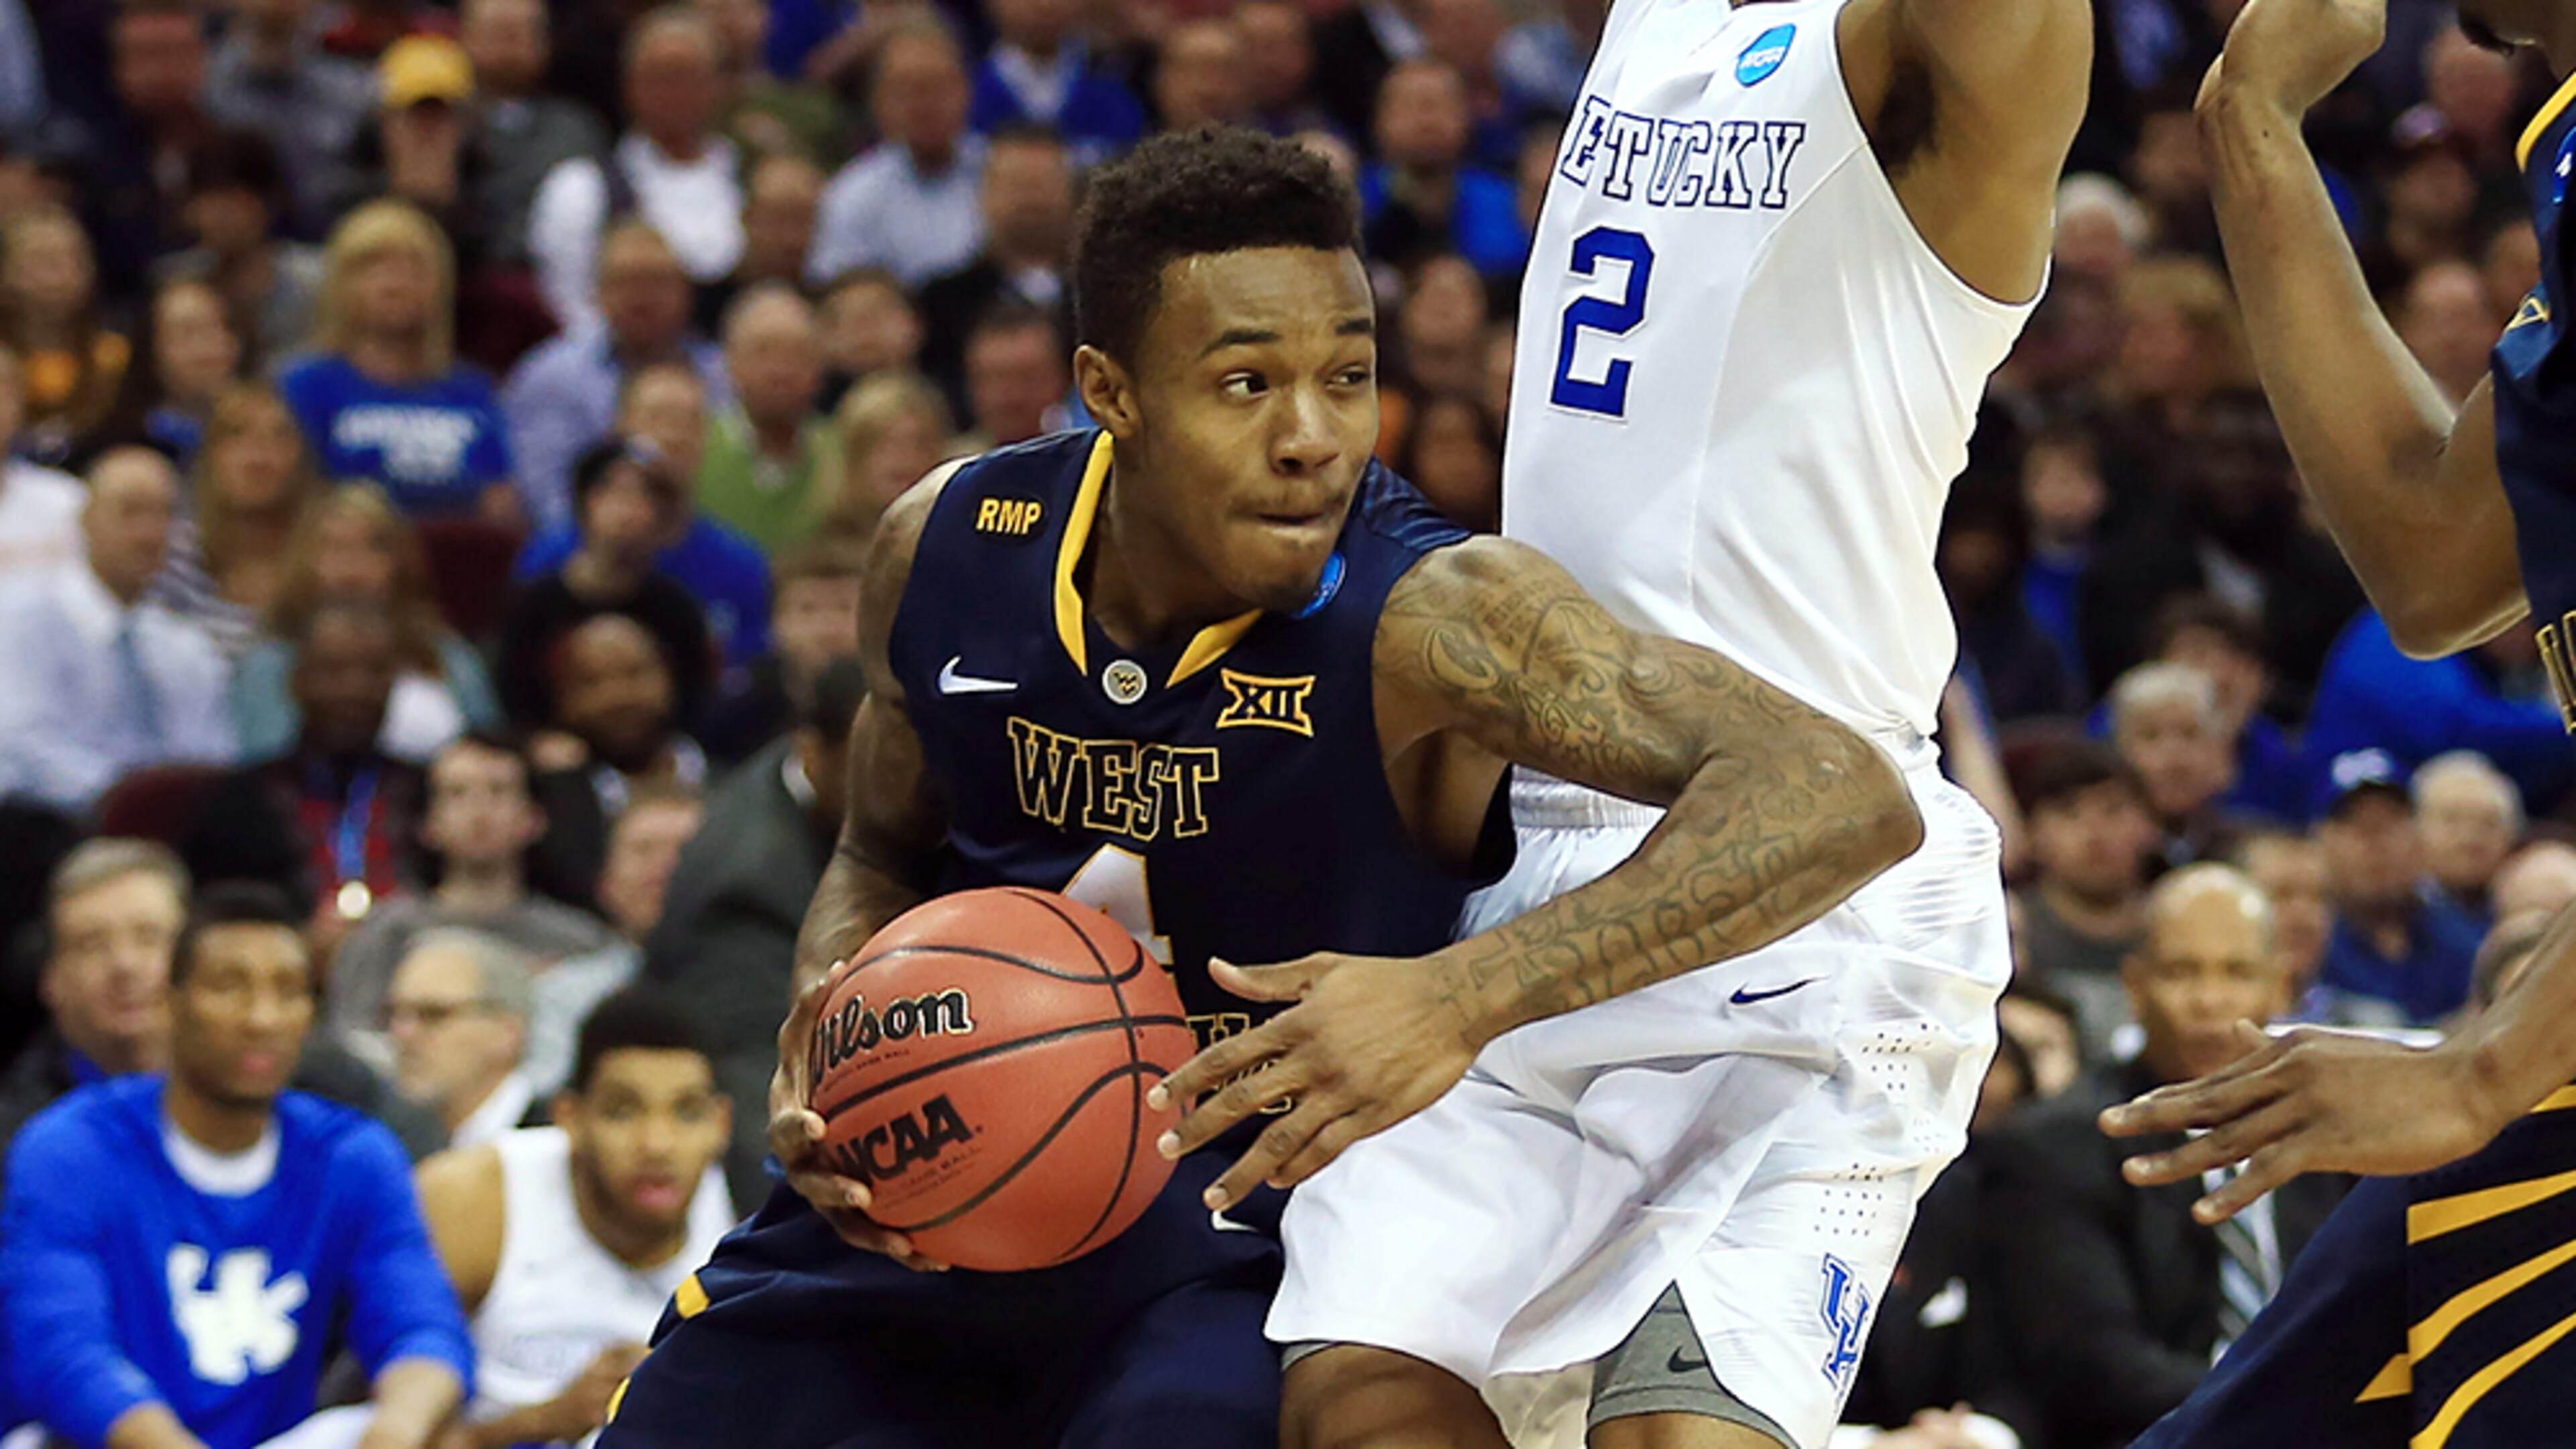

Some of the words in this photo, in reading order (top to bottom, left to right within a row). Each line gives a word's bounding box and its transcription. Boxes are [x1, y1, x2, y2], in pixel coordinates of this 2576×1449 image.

[1550, 225, 1656, 419] 2
[975, 498, 1042, 535] RMP
[1007, 716, 1220, 842] WEST
